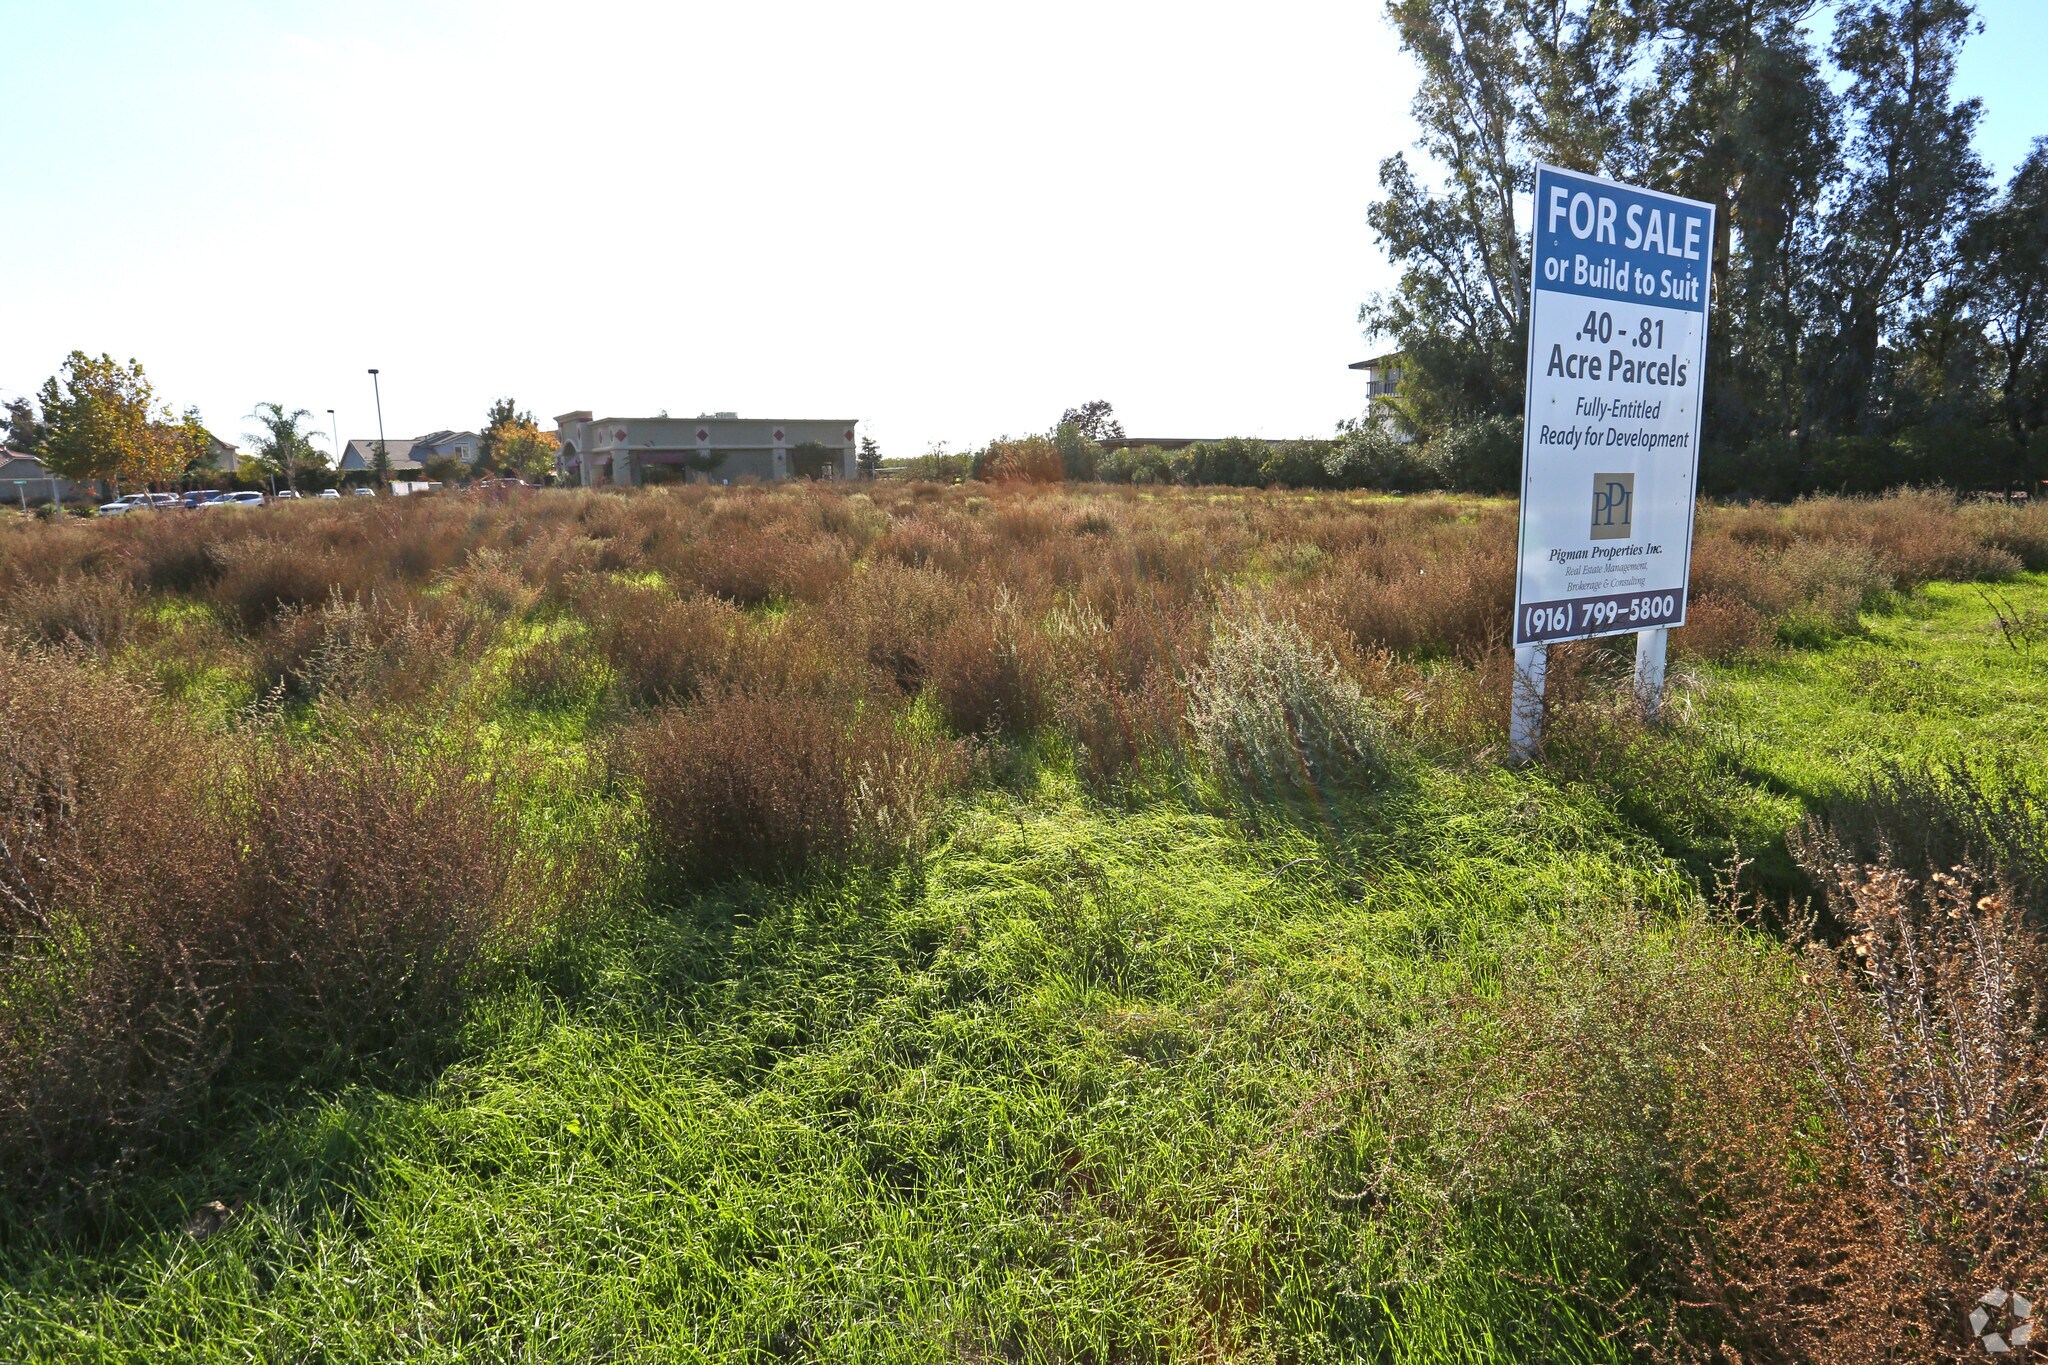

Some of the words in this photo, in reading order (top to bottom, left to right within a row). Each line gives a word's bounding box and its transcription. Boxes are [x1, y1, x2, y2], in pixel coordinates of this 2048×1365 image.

[1549, 185, 1617, 245] FOR
[1624, 203, 1701, 260] SALE
[1544, 257, 1569, 282] or
[1574, 254, 1630, 292] Build
[1634, 268, 1655, 296] to
[1660, 270, 1699, 302] Suit
[1576, 310, 1612, 344] .40
[1632, 317, 1664, 349] .81
[1547, 343, 1601, 380] Acre
[1608, 349, 1687, 387] Parcels
[1576, 396, 1661, 422] Fully-Entitled
[1539, 425, 1582, 450] Ready
[1585, 426, 1604, 446] for
[1606, 428, 1689, 451] Development
[1549, 548, 1588, 564] Pigman
[1591, 544, 1643, 561] Properties
[1646, 543, 1663, 555] Inc.
[1565, 566, 1581, 577] Real
[1582, 564, 1602, 575] Estate
[1603, 561, 1648, 575] Management,
[1567, 581, 1601, 592] Brokerage
[1603, 579, 1609, 588] &
[1610, 576, 1646, 588] Consulting
[1525, 602, 1573, 637] (916)
[1581, 594, 1674, 628] 799-5800
